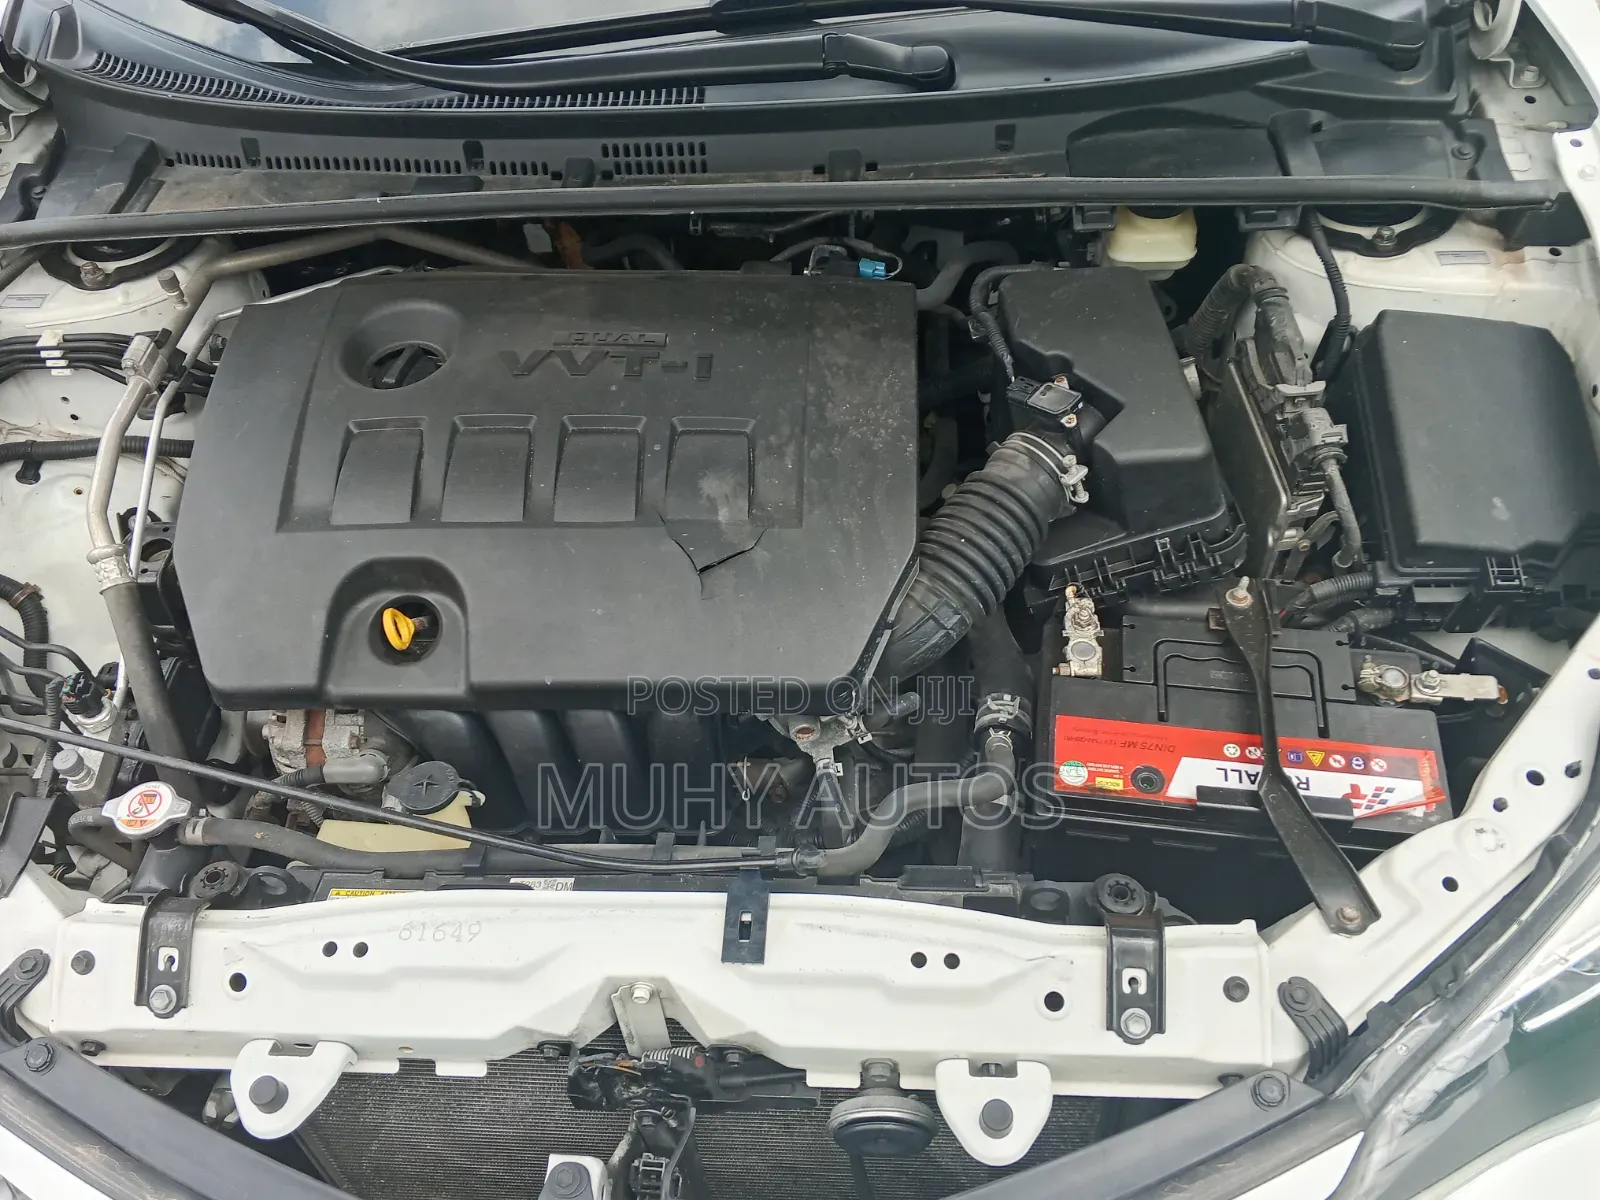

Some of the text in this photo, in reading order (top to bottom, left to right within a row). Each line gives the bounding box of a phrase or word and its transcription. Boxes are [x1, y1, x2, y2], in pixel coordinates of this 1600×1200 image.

[569, 332, 656, 343] DUAL
[1119, 740, 1138, 749] MF
[1140, 742, 1176, 753] DIN75
[1216, 767, 1310, 791] RALL
[399, 920, 480, 942] 61649
